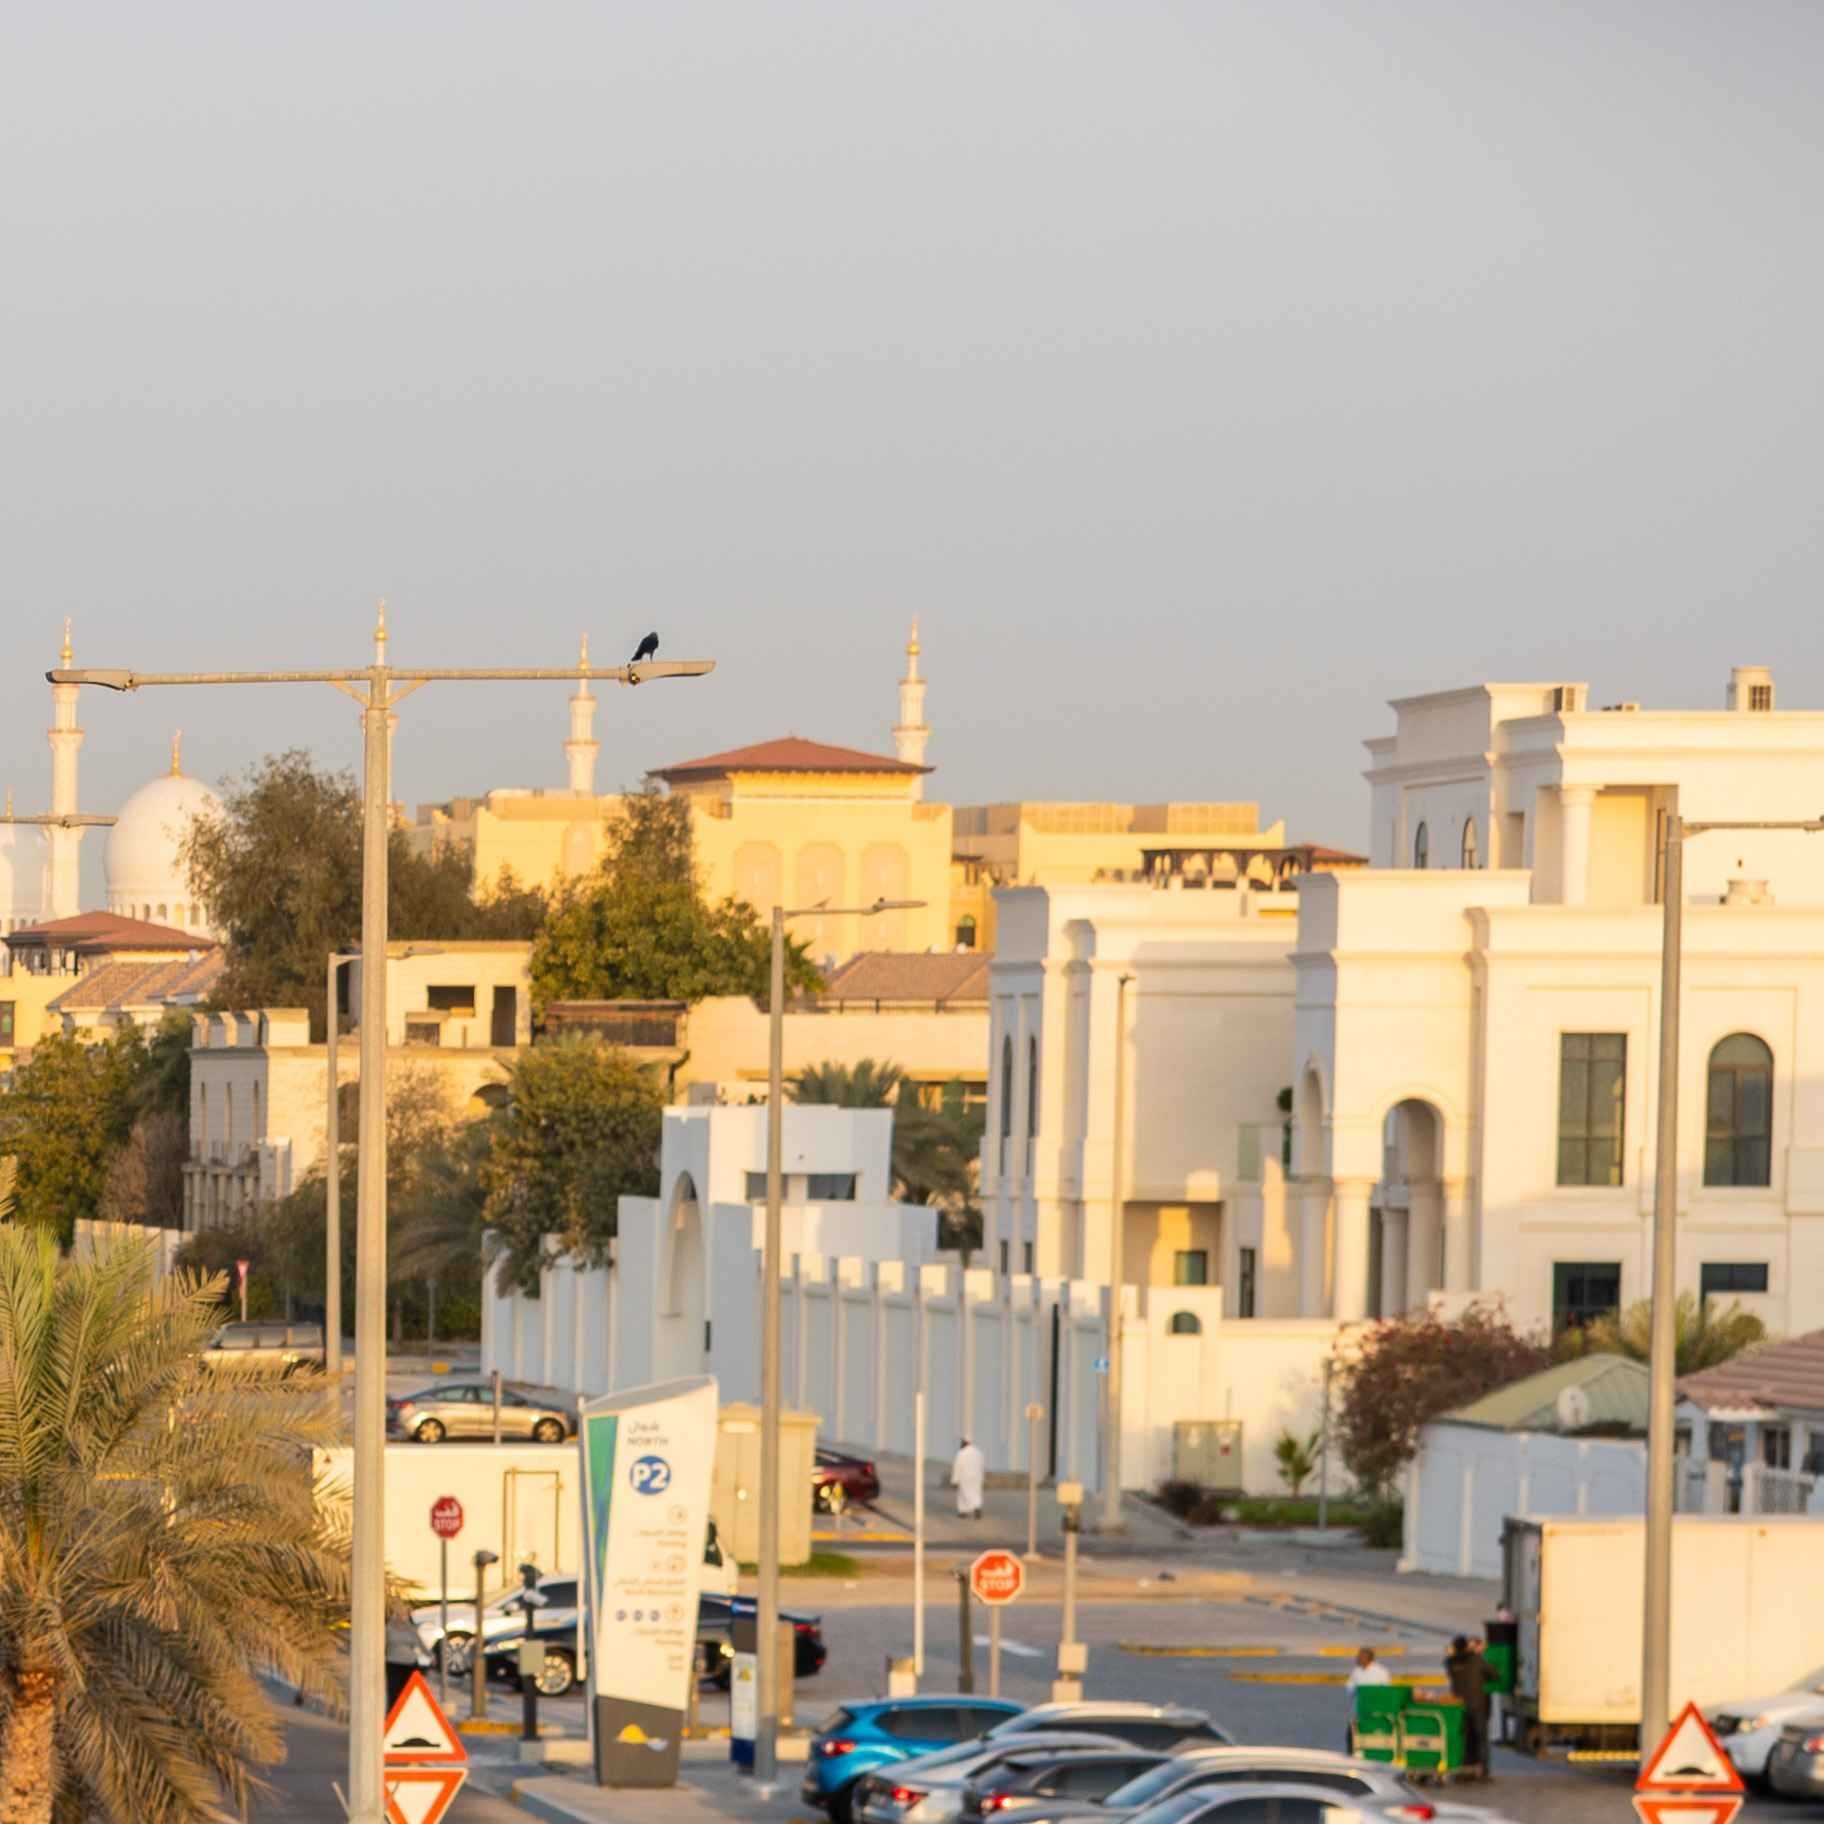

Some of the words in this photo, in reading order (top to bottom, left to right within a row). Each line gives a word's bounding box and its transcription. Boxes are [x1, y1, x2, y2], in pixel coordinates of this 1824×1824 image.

[627, 1437, 669, 1446] NORTH
[633, 1462, 668, 1489] P2
[434, 1518, 460, 1529] STOP
[980, 1579, 1014, 1592] STOP
